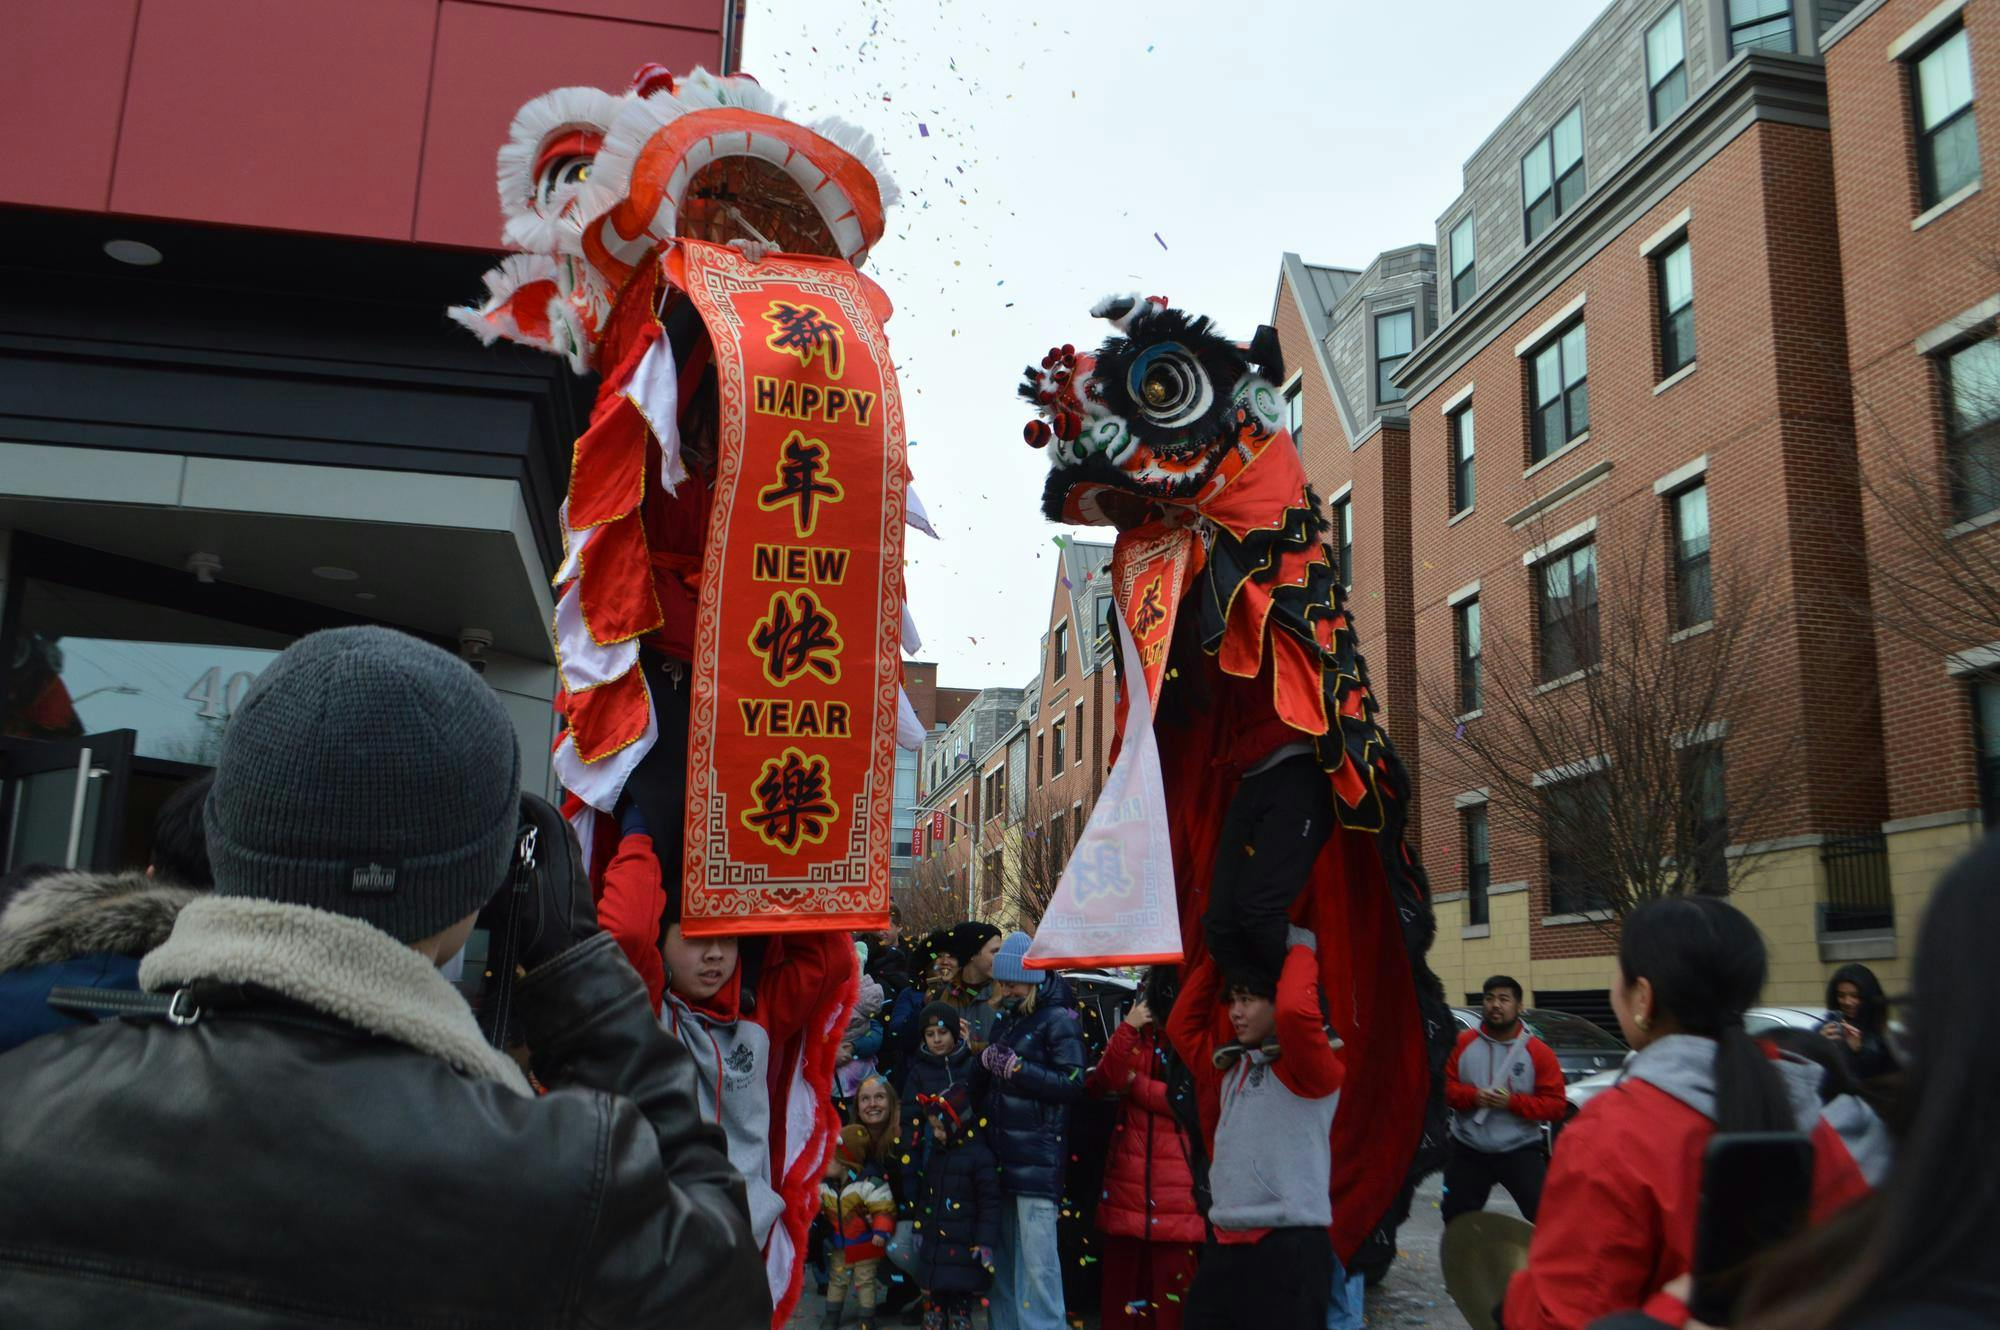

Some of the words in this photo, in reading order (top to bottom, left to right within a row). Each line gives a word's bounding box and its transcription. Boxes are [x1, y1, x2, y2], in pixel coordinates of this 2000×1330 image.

[764, 302, 844, 377] 新
[755, 377, 875, 424] HAPPY
[760, 433, 842, 534] 年
[754, 546, 848, 583] NEW
[750, 590, 841, 684] 快
[740, 700, 850, 736] YEAR
[743, 750, 837, 851] 樂
